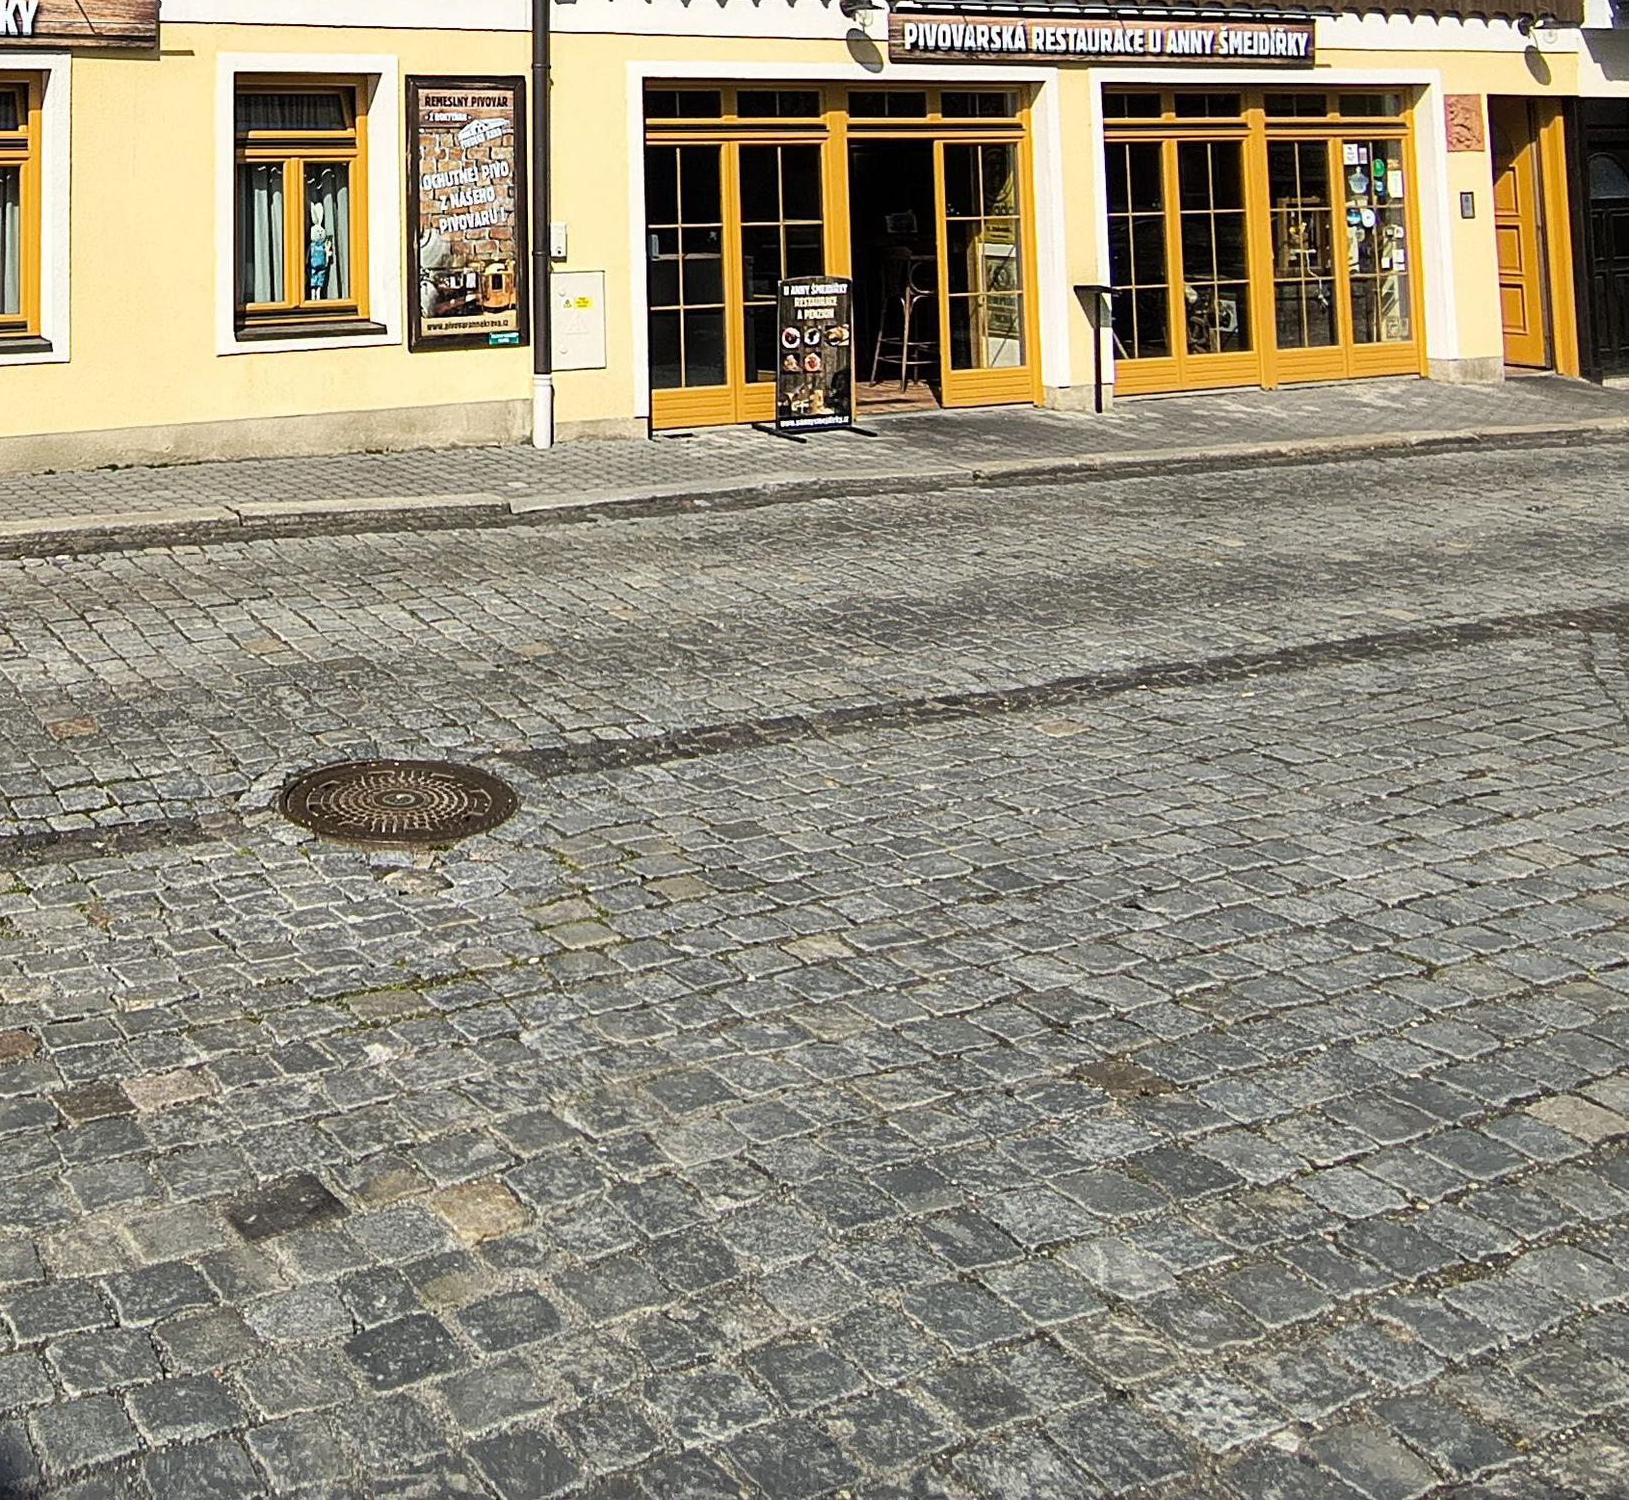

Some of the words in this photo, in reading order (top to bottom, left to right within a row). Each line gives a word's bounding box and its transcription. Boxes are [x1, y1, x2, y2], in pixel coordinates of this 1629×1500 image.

[904, 20, 1027, 52] PIVOVARSKÁ
[1031, 25, 1145, 54] RESTAURACE
[1149, 28, 1163, 54] U
[1167, 28, 1215, 55] ANNY
[1218, 26, 1309, 57] ŠMEJDÍŘKY
[471, 95, 508, 108] PIVOVAR
[423, 167, 478, 191] OCHUTNEJ
[481, 160, 509, 180] PIVO
[440, 195, 448, 211] Z
[783, 285, 790, 296] U
[790, 284, 810, 295] ANNY
[797, 309, 803, 320] A
